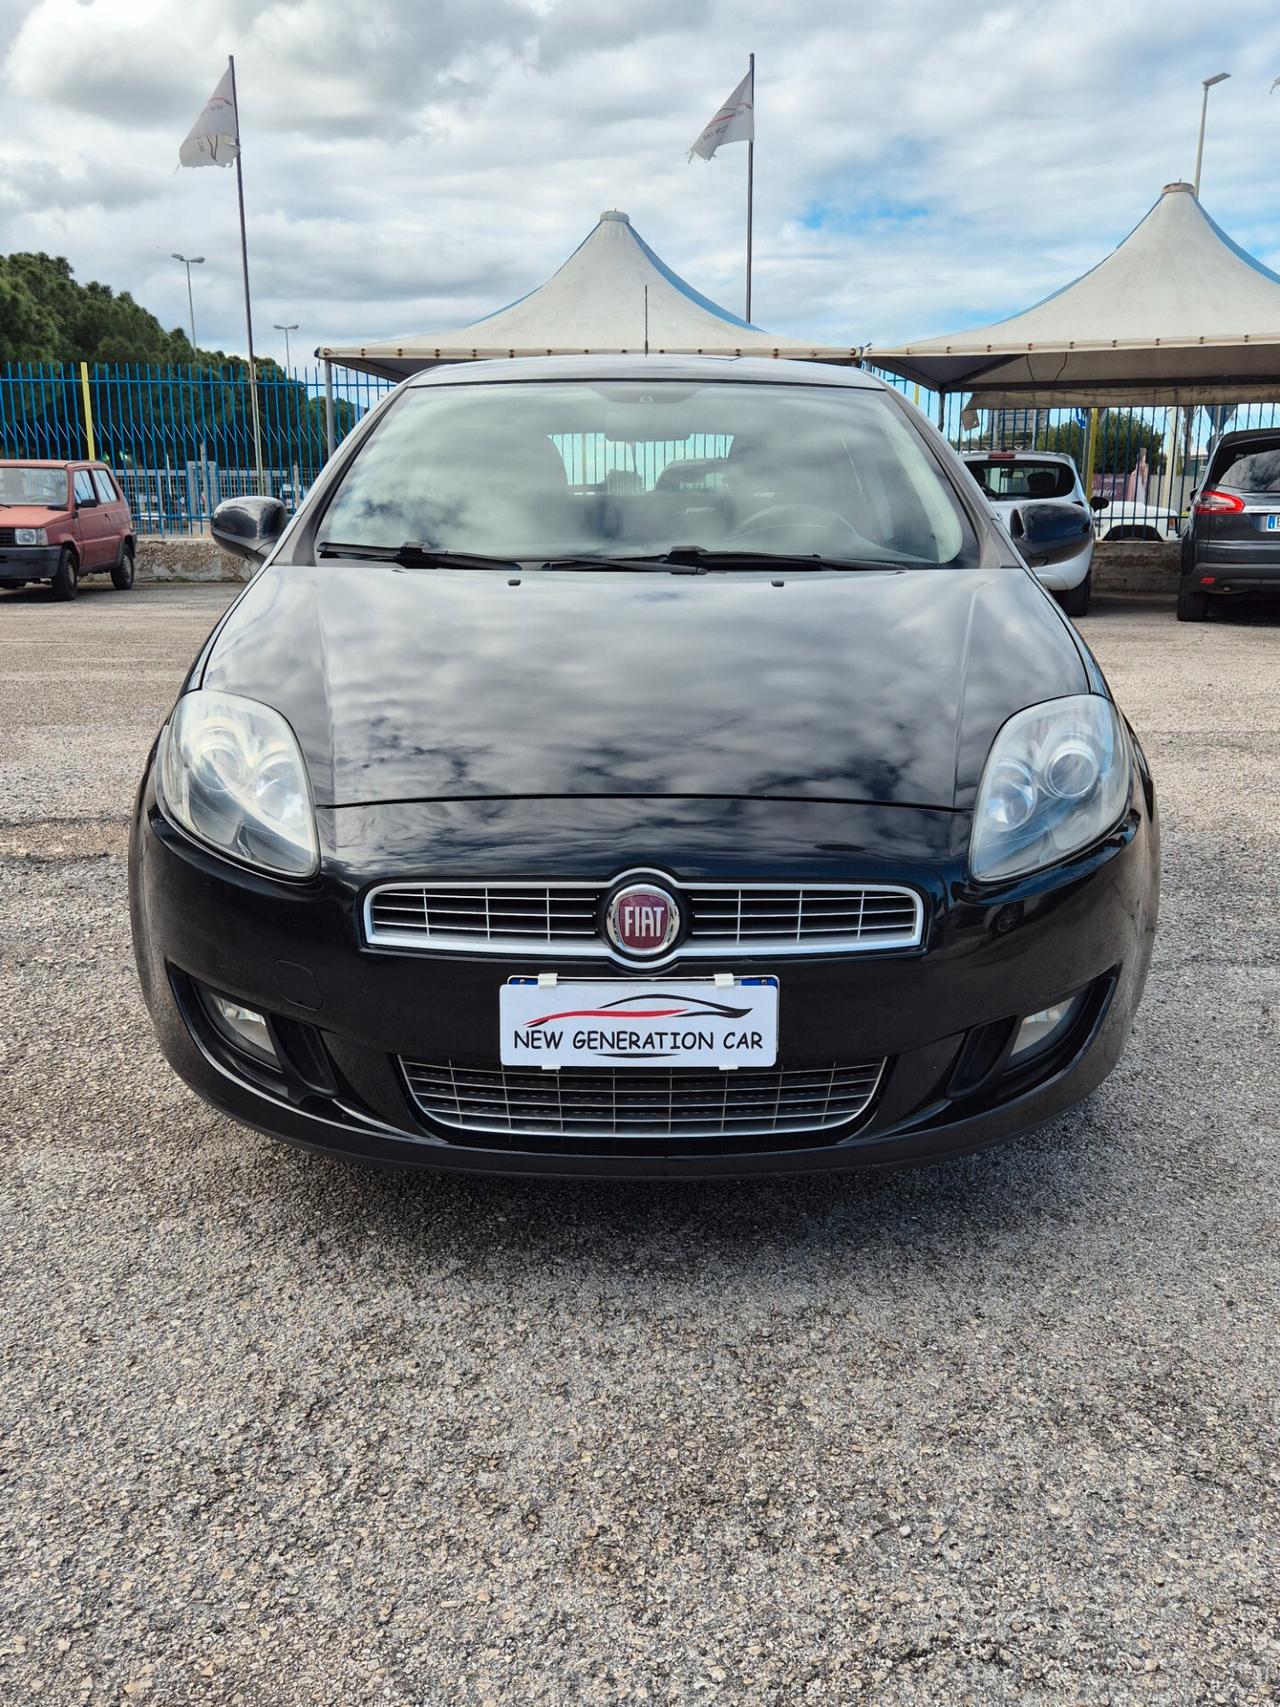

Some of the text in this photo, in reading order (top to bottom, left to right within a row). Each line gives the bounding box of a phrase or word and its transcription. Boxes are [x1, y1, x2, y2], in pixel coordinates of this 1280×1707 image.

[624, 906, 665, 937] FIAT
[514, 1030, 763, 1050] NEW GENERATION CAR
